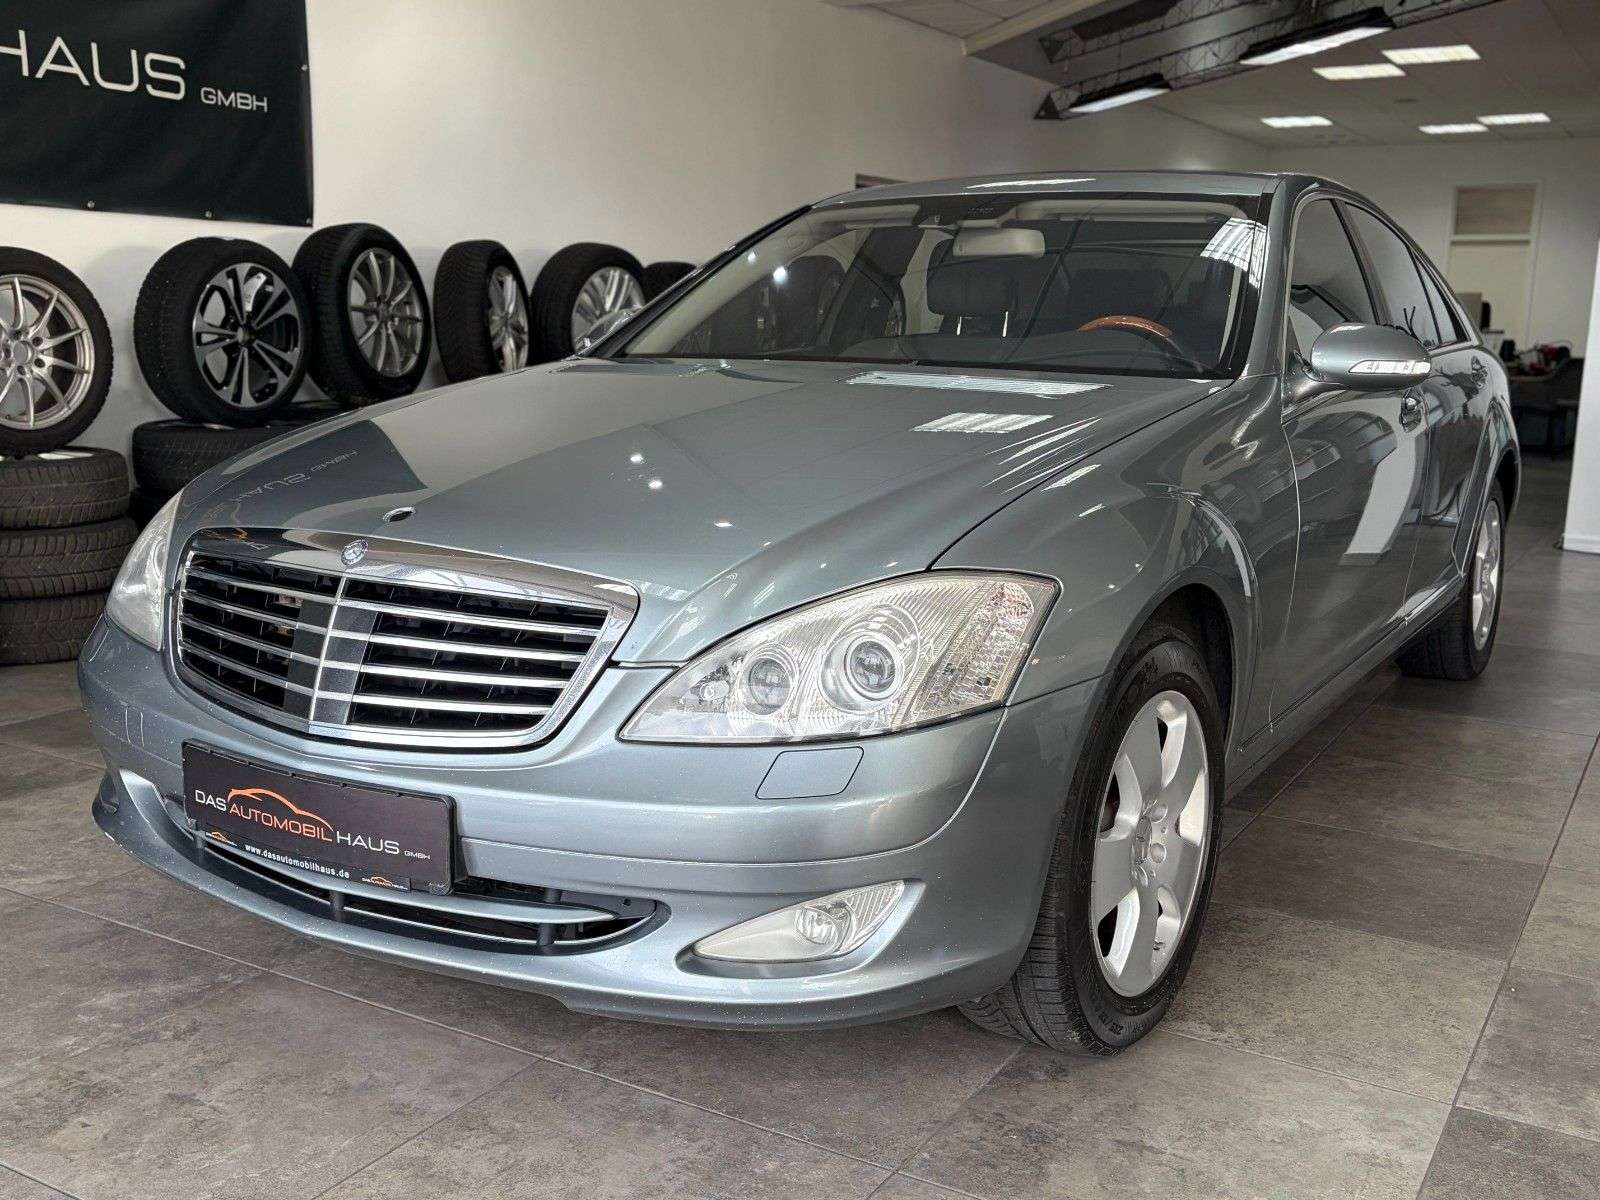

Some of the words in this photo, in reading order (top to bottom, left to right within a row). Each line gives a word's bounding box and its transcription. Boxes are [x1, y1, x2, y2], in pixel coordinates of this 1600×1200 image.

[200, 87, 268, 112] GMBH
[336, 830, 400, 855] HAUS
[404, 850, 431, 860] GMBH
[244, 843, 351, 879] www.dasautomobilhaus.de
